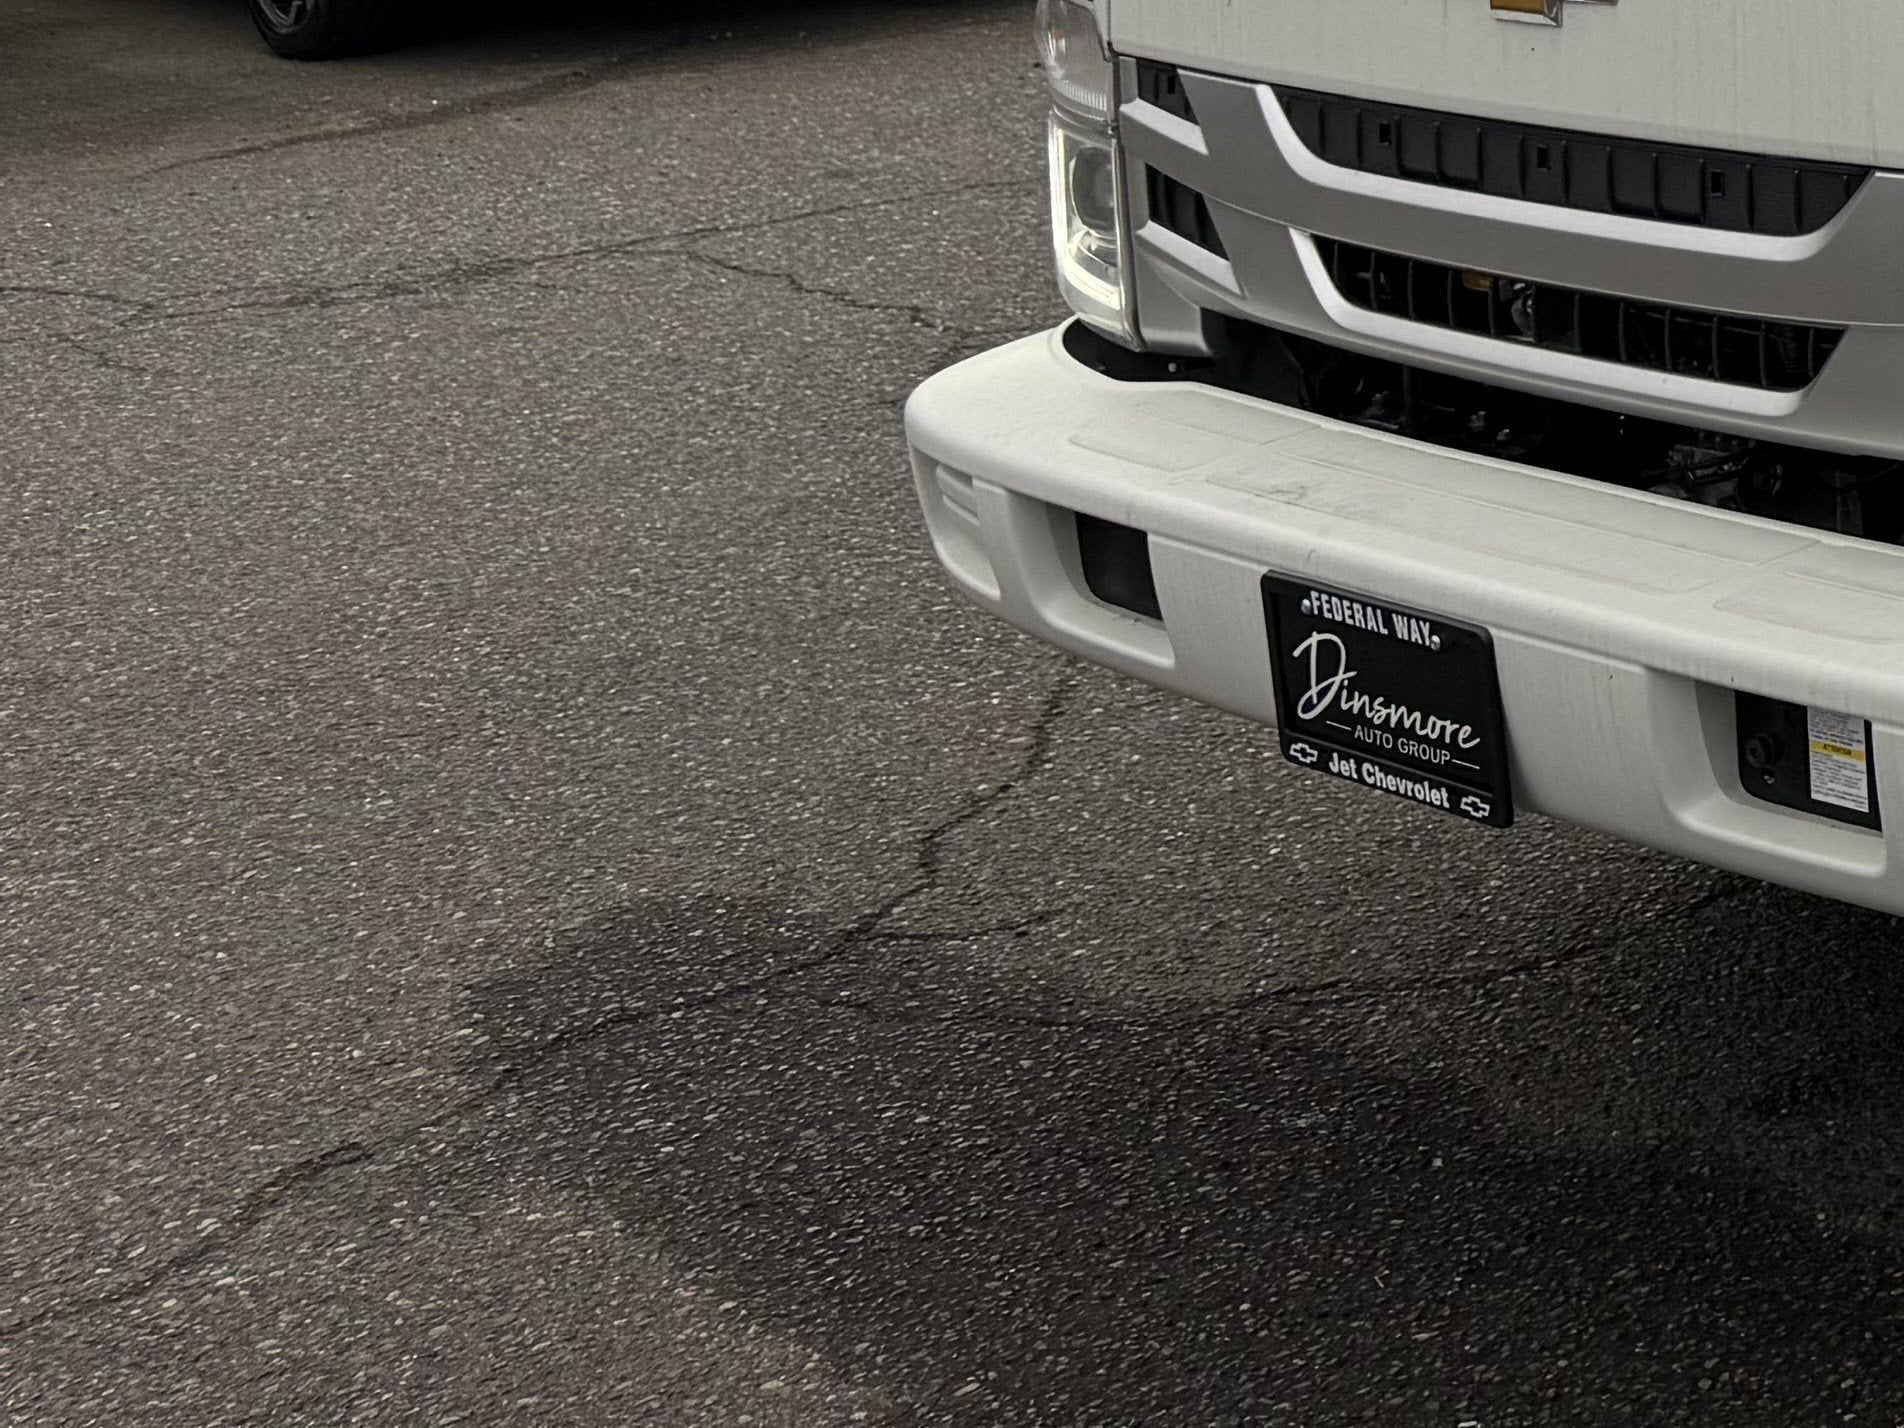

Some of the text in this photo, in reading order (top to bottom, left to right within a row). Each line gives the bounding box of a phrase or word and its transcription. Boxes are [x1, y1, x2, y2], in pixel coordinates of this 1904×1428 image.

[1310, 590, 1430, 646] FEDERAL WAY
[1292, 631, 1481, 749] Dinsmore
[1354, 724, 1451, 765] AUTO GROUP
[1328, 752, 1450, 809] Jet Chevrolet
